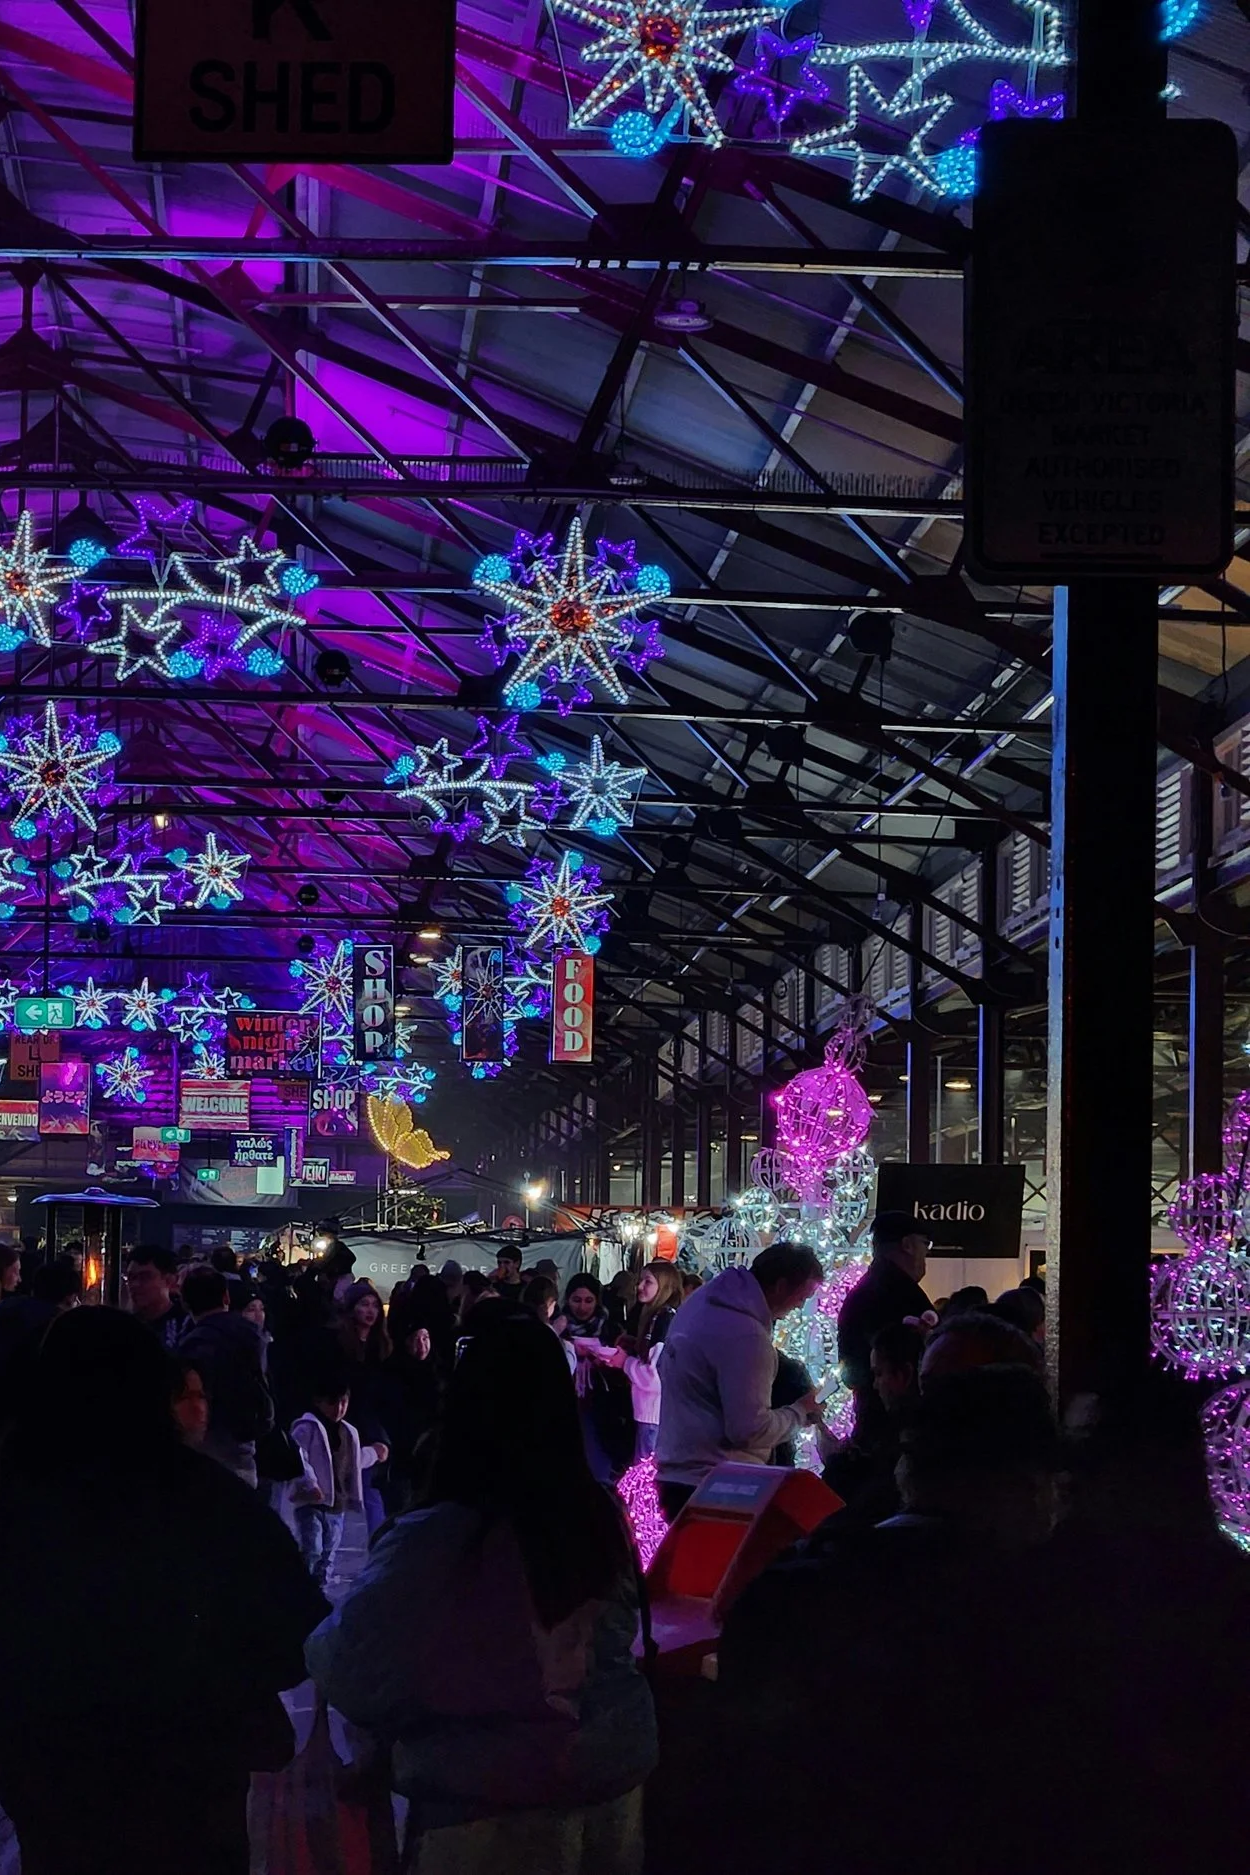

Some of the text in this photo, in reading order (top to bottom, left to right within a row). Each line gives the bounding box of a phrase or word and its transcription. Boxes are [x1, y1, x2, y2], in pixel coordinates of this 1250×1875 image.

[189, 59, 396, 134] SHED
[1092, 392, 1208, 415] VICTORIA
[1051, 424, 1151, 446] MARKET
[1024, 457, 1181, 480] AUTHORISED
[1041, 489, 1163, 513] VEHICLES
[1036, 521, 1166, 546] EXCEPTED
[362, 950, 387, 1054] SHOP
[563, 959, 584, 1052] FOOD
[235, 1014, 311, 1032] winter
[242, 1032, 302, 1053] night
[230, 1052, 316, 1072] market
[41, 1089, 87, 1105] ようこそ
[182, 1096, 248, 1114] WELCOME
[312, 1089, 356, 1110] SHOP
[913, 1200, 986, 1222] kadio
